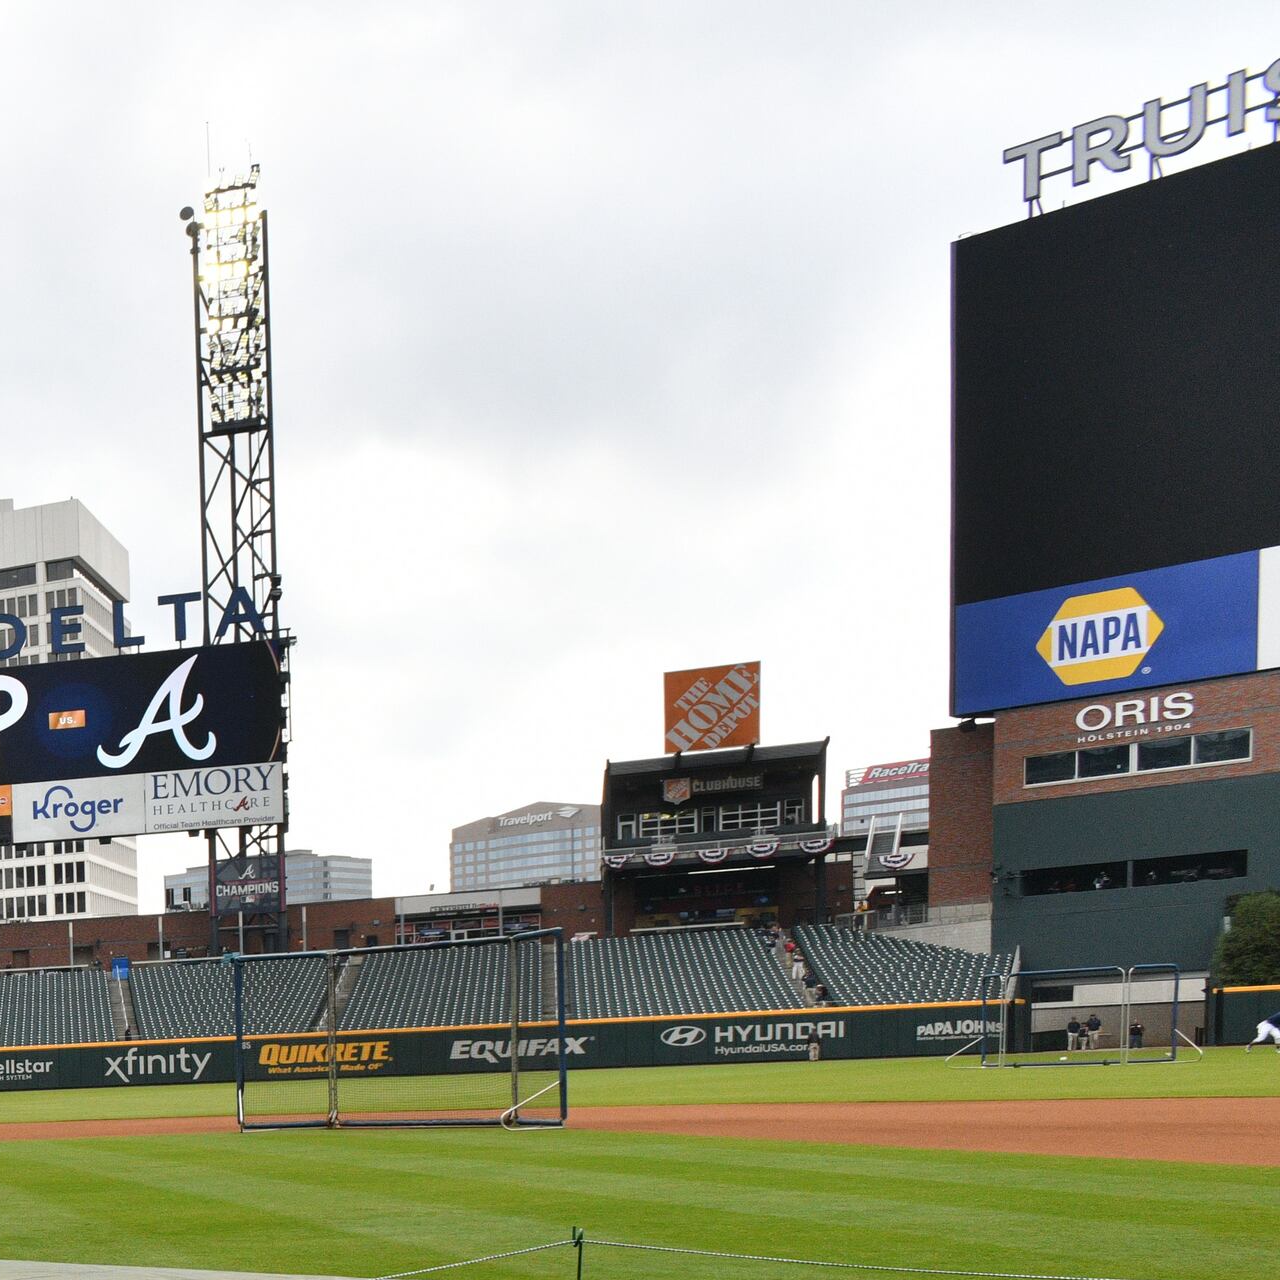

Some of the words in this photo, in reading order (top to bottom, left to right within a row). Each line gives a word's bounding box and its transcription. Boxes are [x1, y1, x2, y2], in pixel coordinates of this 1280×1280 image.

[1003, 57, 1280, 202] TRUI
[1058, 612, 1141, 661] NAPA
[665, 664, 760, 751] HOME
[673, 677, 714, 711] THE
[97, 653, 217, 768] A
[703, 693, 760, 749] DEPOT
[1075, 692, 1195, 731] ORIS
[1077, 728, 1149, 743] HOLSTEIN
[1156, 723, 1192, 733] 1904
[152, 765, 276, 799] EMORY
[692, 775, 761, 793] CLUBHOUSE
[869, 762, 929, 779] RaceTra
[32, 786, 123, 832] Kroger
[153, 796, 271, 816] HEALTHCARE
[498, 810, 553, 828] Travelport
[153, 822, 179, 830] Official
[181, 821, 200, 829] Team
[202, 817, 242, 827] Healthcare
[243, 815, 275, 824] Provider
[215, 881, 279, 897] CHAMPIONS
[715, 1021, 845, 1043] HYUNDAI
[450, 1036, 591, 1063] EQUIFAX
[5, 1073, 32, 1081] SYSTEM
[104, 1047, 212, 1083] xfinity
